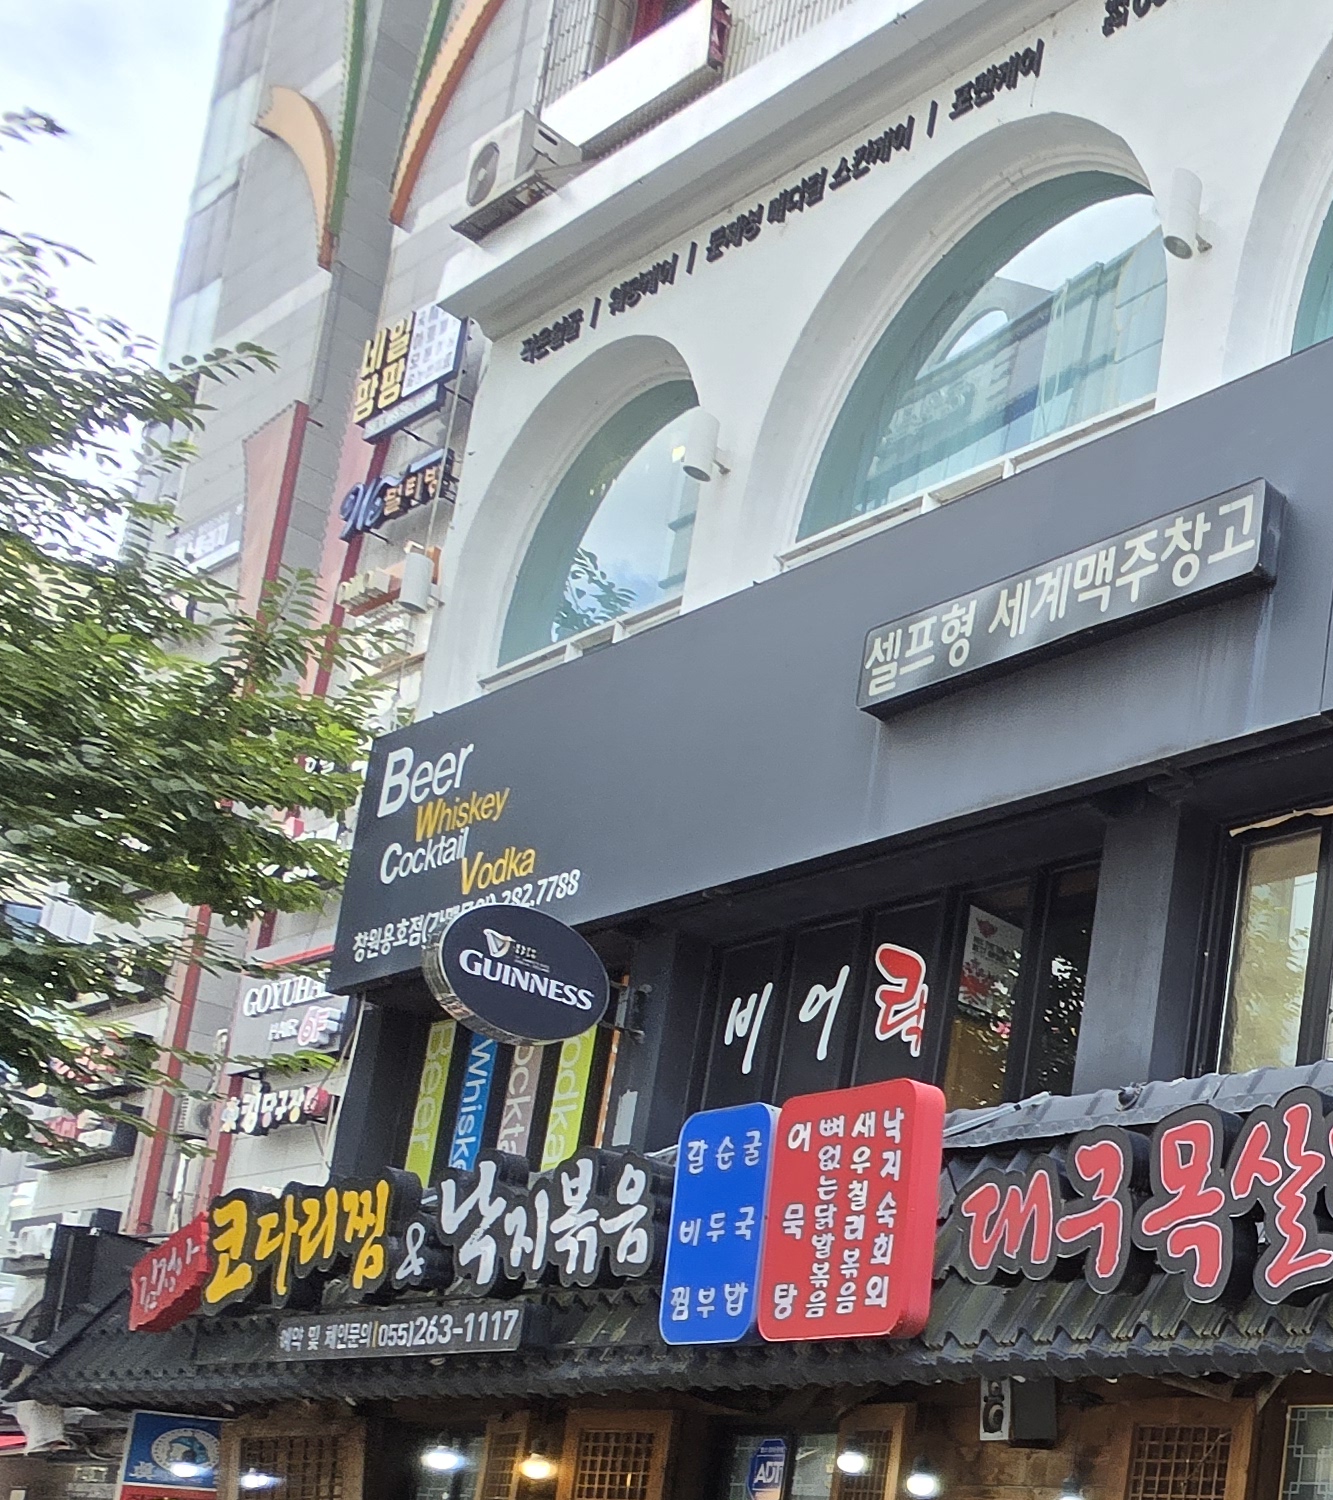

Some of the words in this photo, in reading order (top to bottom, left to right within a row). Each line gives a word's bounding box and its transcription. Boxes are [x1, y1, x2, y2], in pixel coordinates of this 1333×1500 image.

[864, 599, 977, 697] 셀프형
[989, 494, 1255, 639] 세계맥주창고
[377, 743, 474, 818] Beer
[415, 787, 510, 842] Whiskey
[380, 827, 469, 884] Cocktail
[461, 846, 535, 895] Vodka
[459, 949, 595, 1010] GUINNESS
[411, 1027, 452, 1151] Beer
[543, 1036, 588, 1165] odka
[205, 1180, 389, 1303] 코다리찜
[396, 1222, 425, 1280] &
[440, 1158, 648, 1284] 낙지볶음
[754, 1461, 784, 1483] ADT
